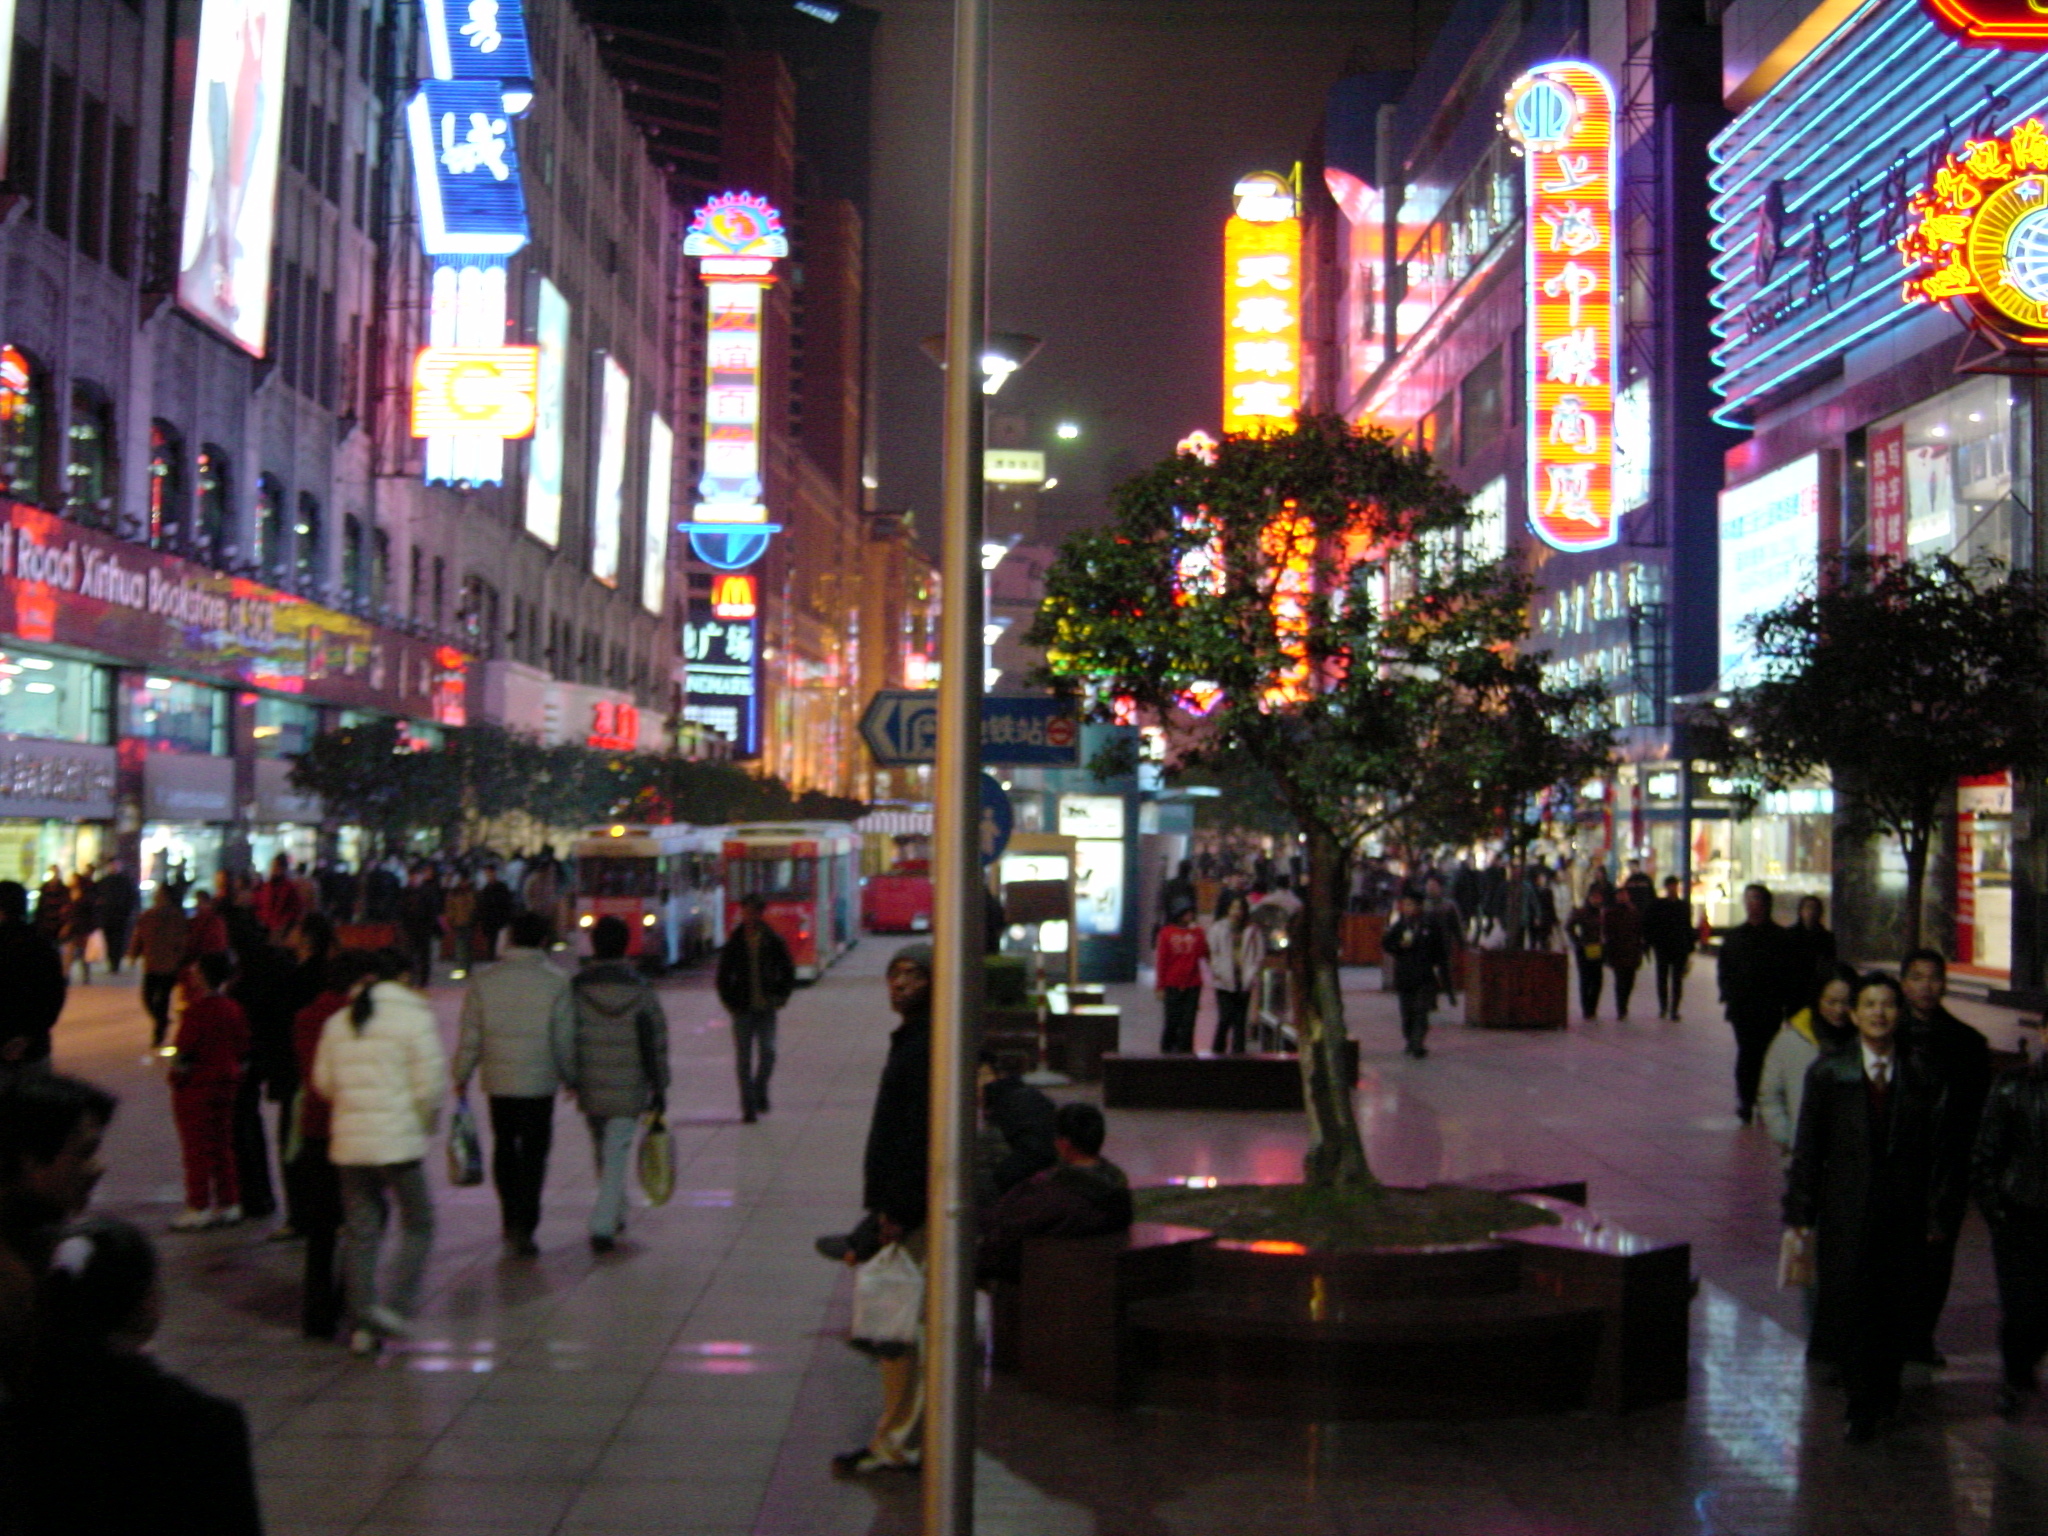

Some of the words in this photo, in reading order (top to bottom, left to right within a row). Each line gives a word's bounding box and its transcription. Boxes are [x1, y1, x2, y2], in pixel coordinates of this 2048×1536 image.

[17, 526, 78, 592] Road
[80, 544, 146, 610] Xinhua
[148, 567, 228, 630] Bookstore
[982, 714, 1043, 745] 铁站
